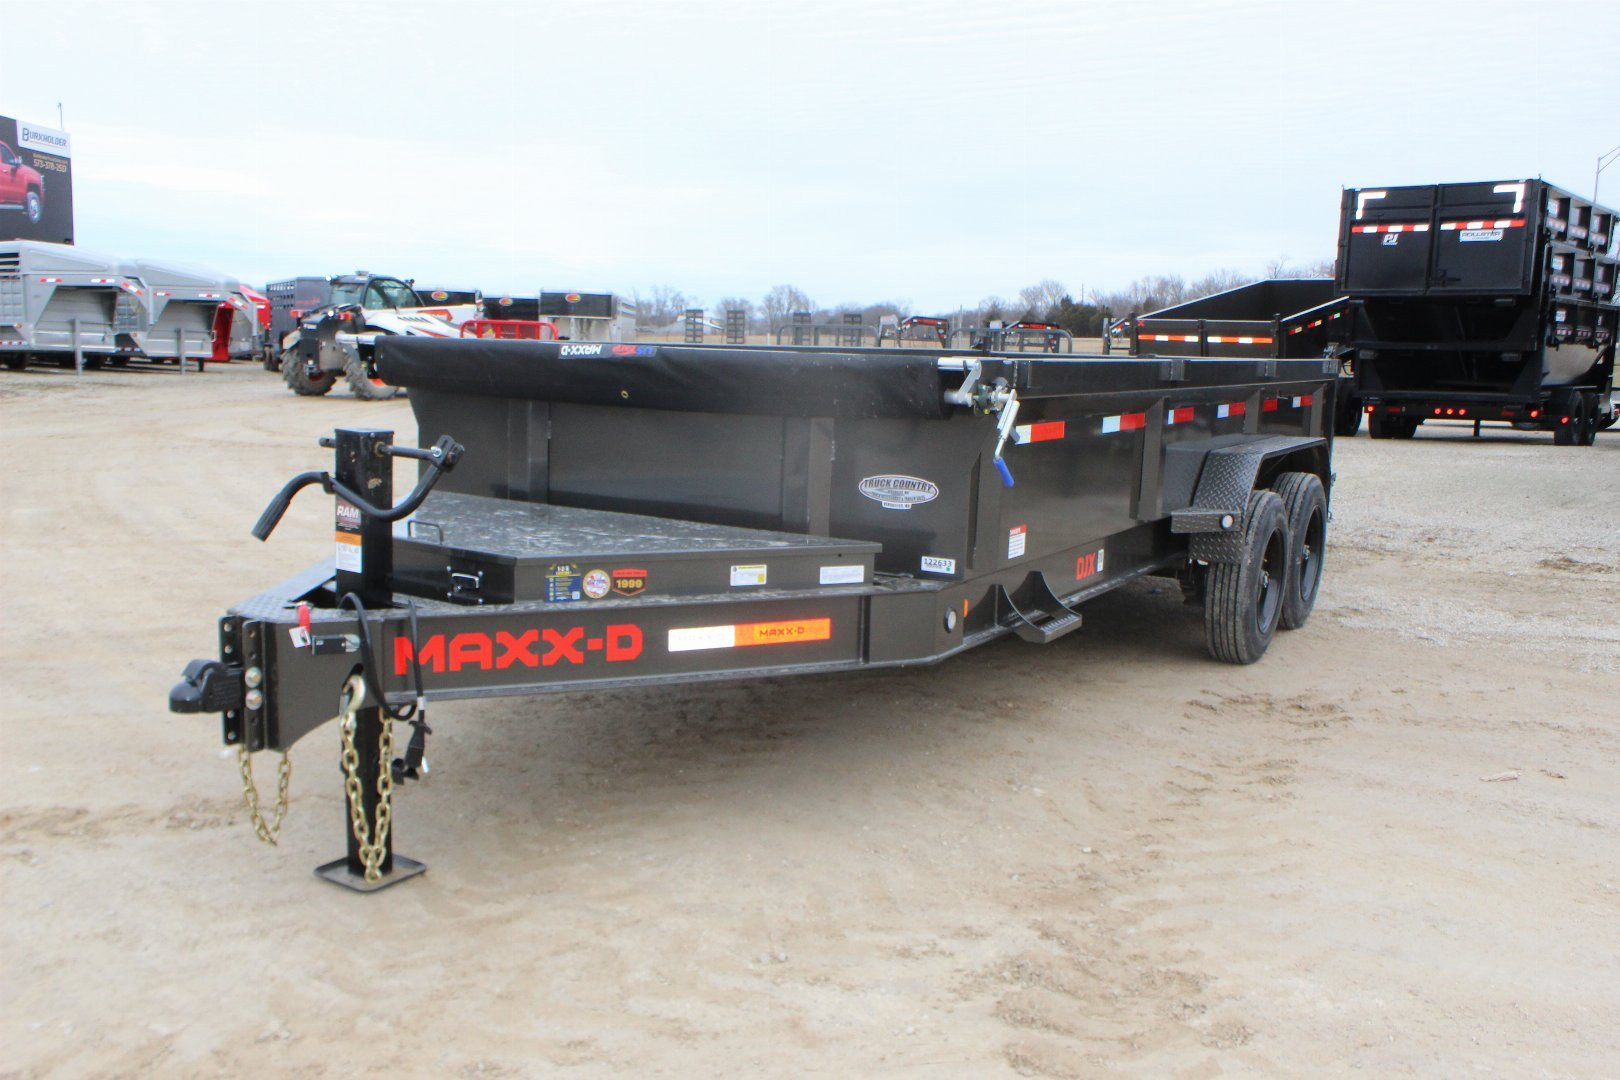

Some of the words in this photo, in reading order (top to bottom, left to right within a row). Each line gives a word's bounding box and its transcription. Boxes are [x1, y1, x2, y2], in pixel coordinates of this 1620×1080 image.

[22, 128, 66, 147] BURKHOLDER
[863, 478, 892, 488] TRUCK
[893, 479, 934, 492] COUNTRY
[336, 504, 360, 519] RAM
[616, 579, 643, 589] 1999
[759, 626, 805, 639] MAXX-D
[394, 624, 643, 675] MAXX-D
